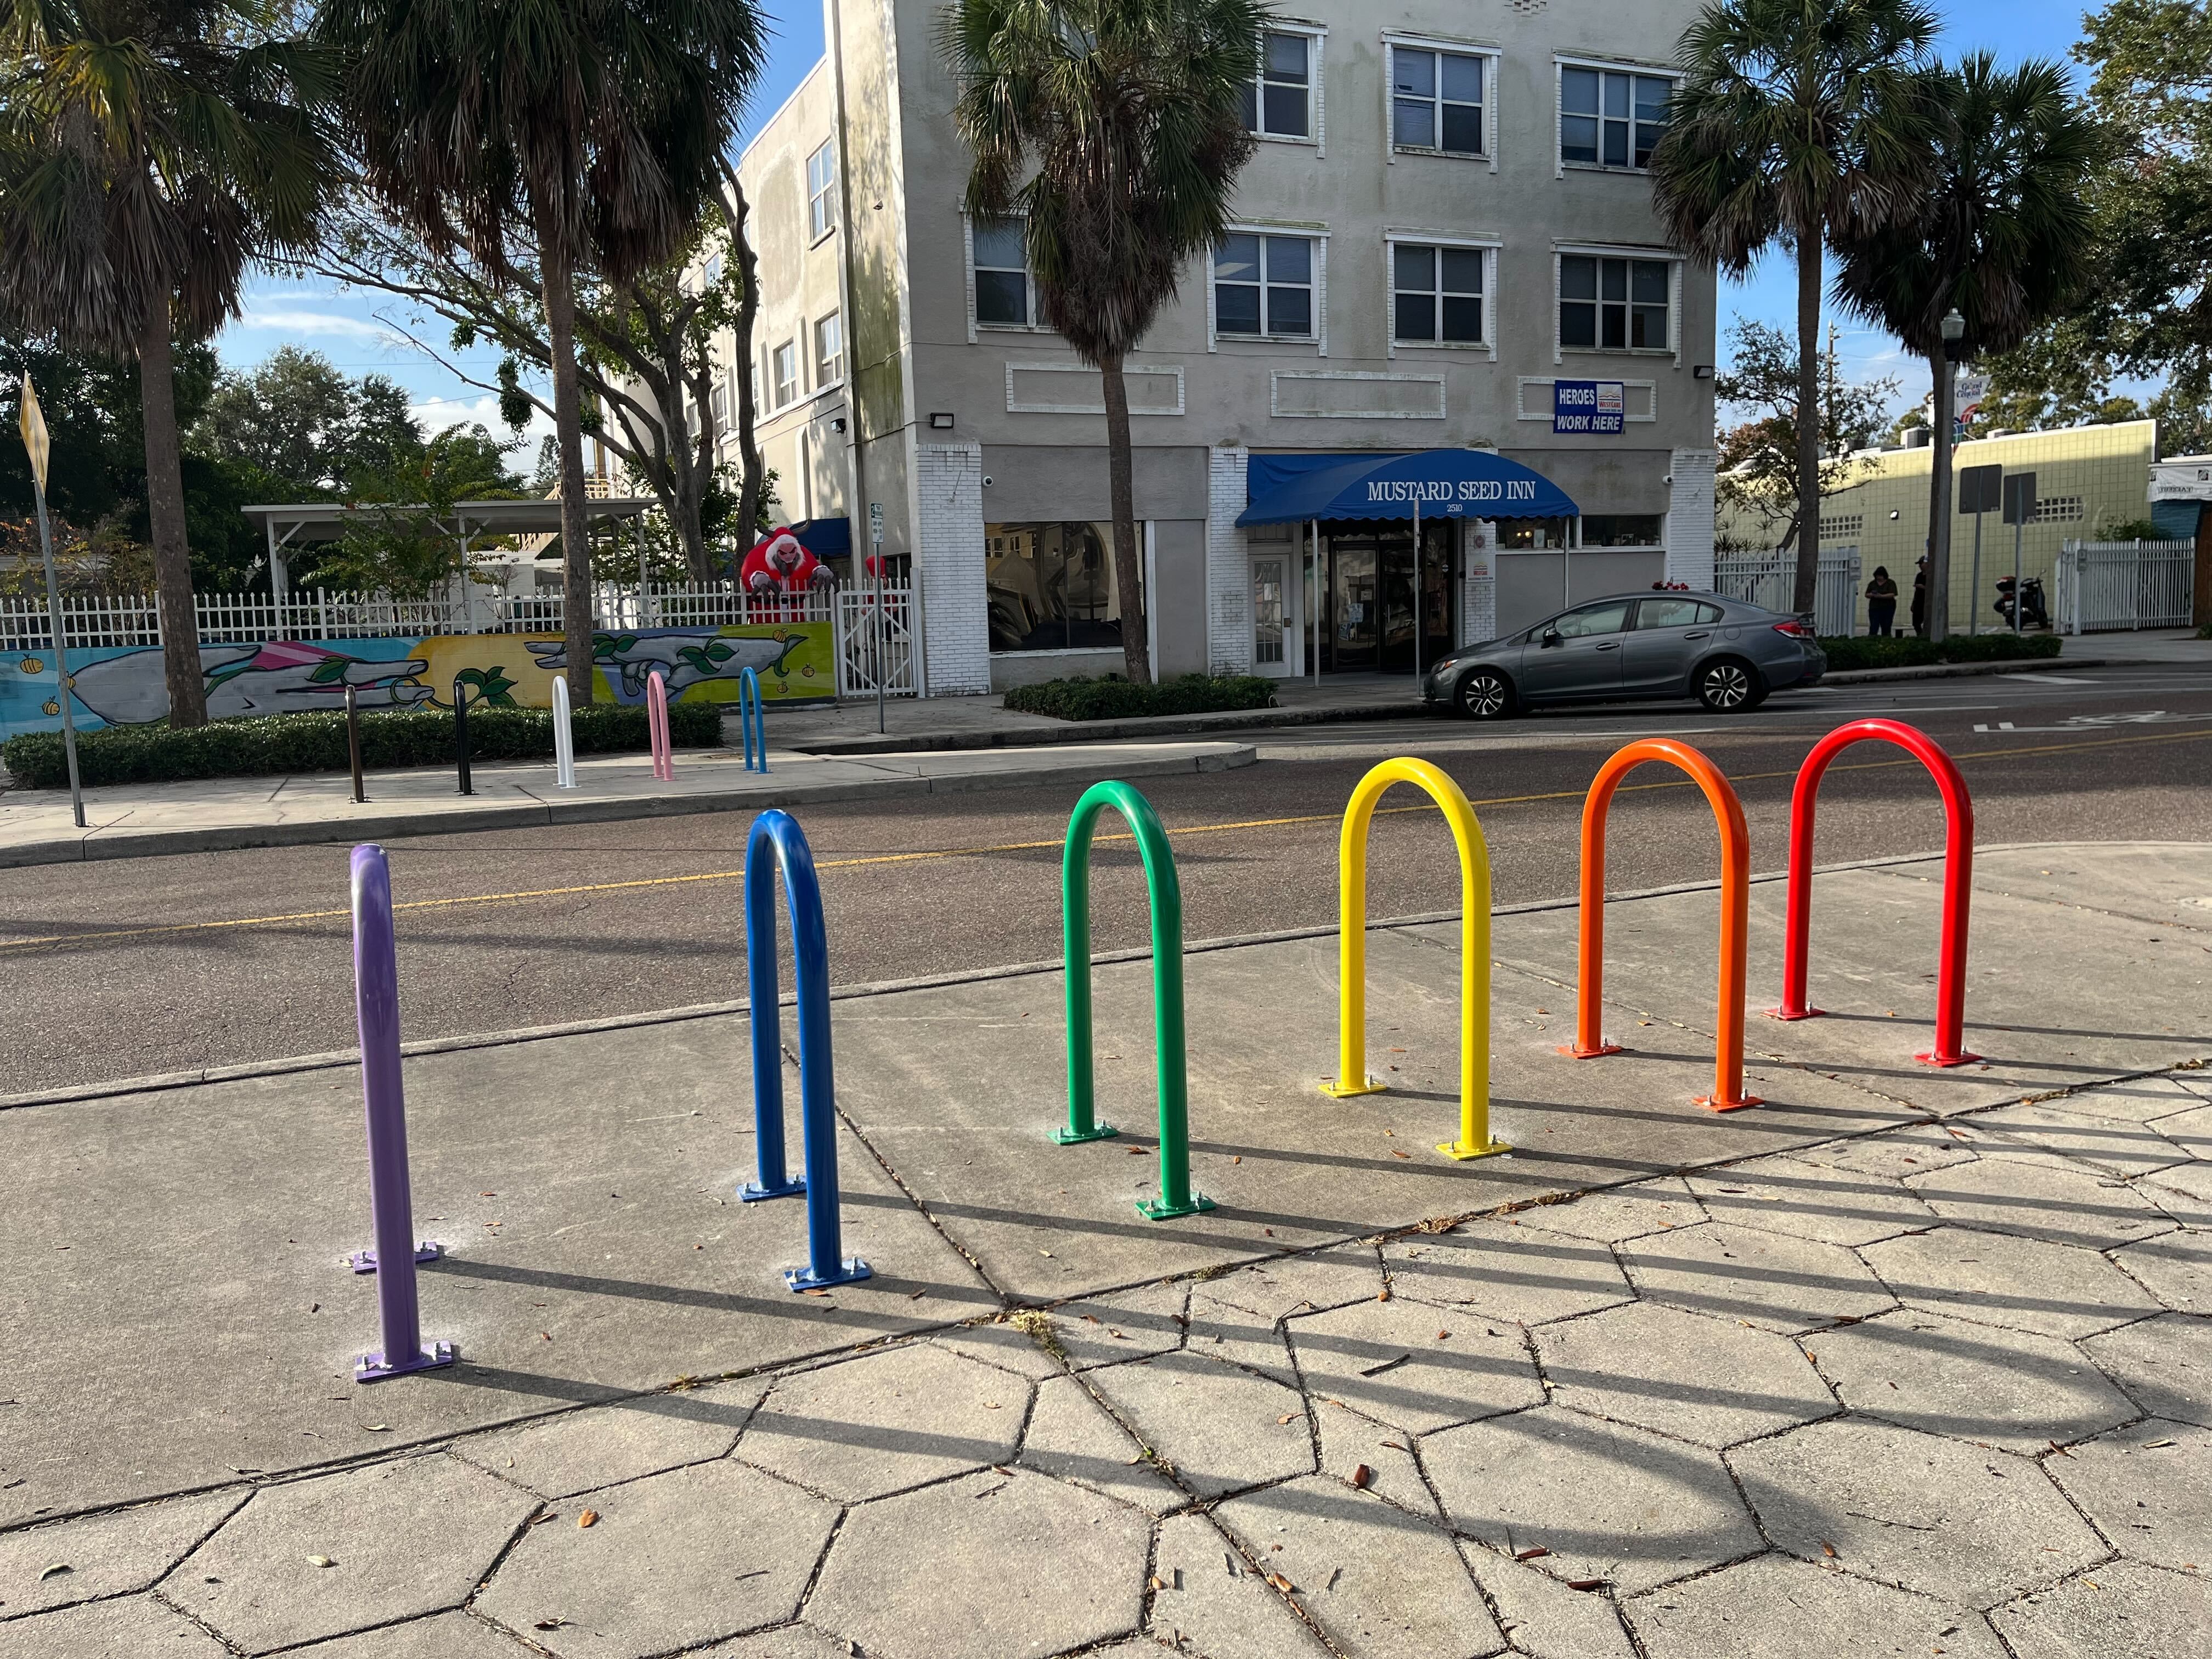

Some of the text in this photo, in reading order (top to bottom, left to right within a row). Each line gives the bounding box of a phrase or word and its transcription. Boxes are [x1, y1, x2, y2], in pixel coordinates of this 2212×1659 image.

[1559, 388, 1595, 405] HEROES
[1558, 415, 1621, 431] WORK HERE
[1367, 481, 1536, 501] MUSTARD SEED INN
